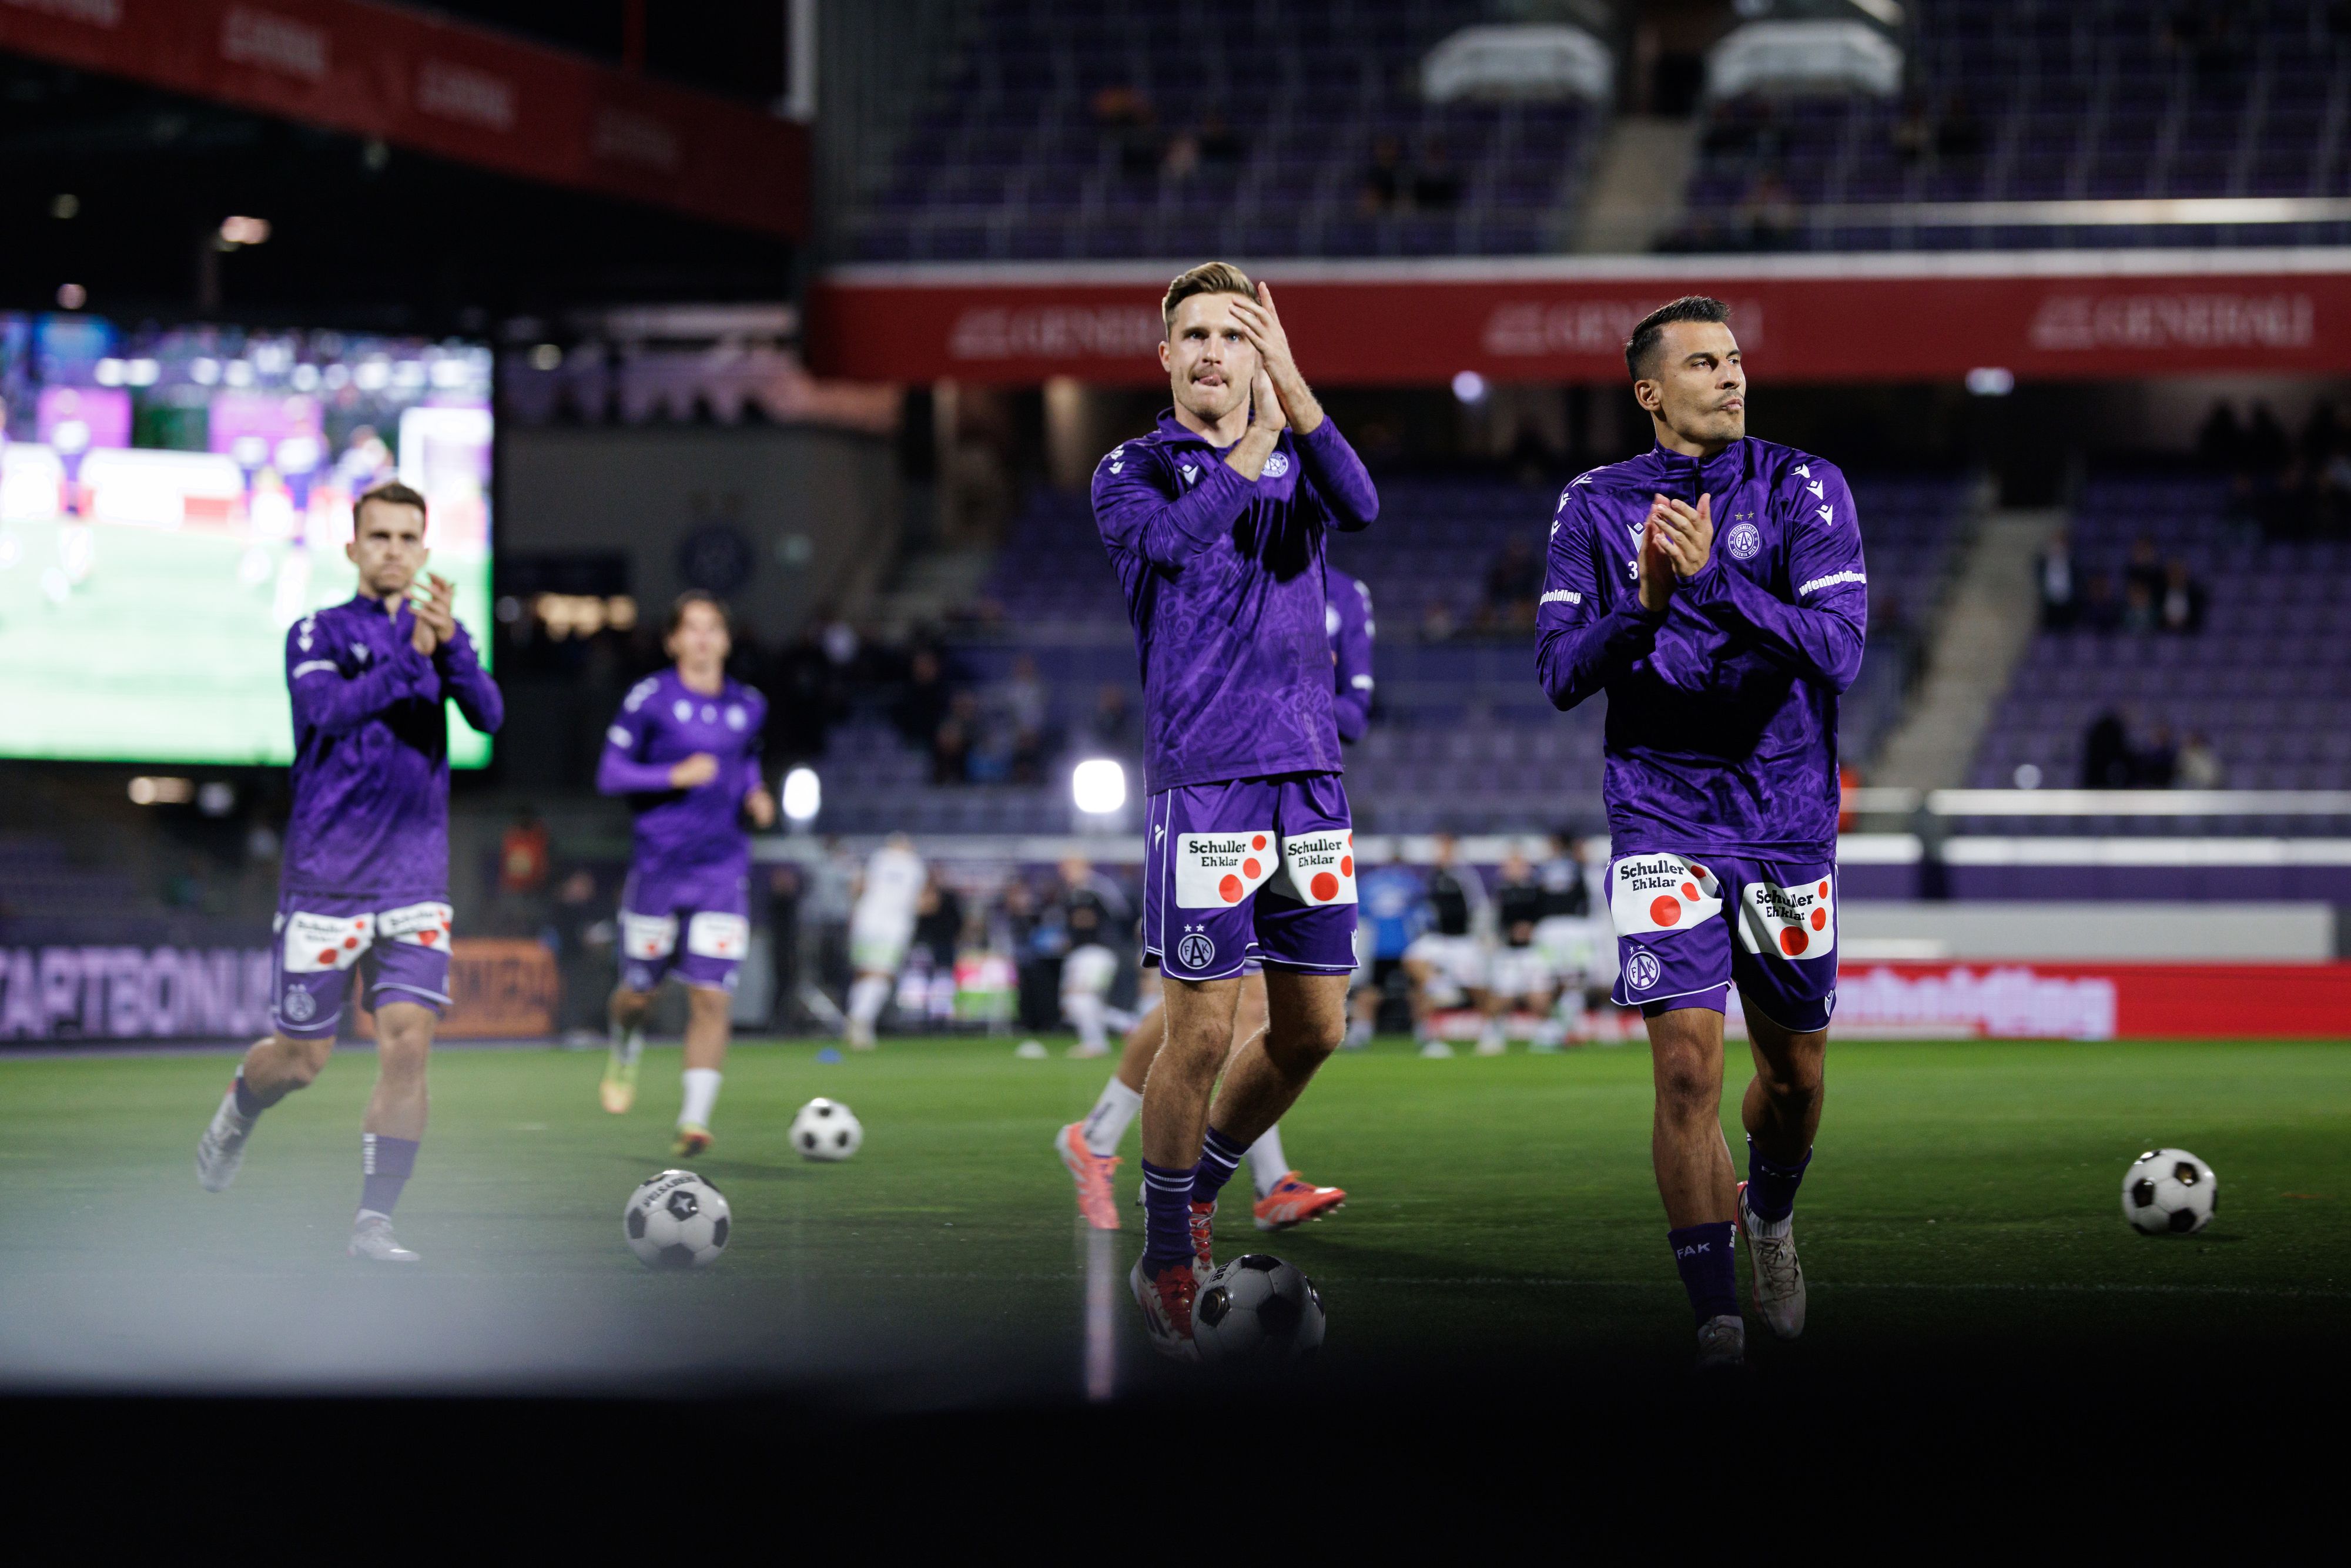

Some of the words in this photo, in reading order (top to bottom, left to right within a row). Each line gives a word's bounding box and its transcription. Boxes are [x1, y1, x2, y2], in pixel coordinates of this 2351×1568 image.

[1731, 525, 1757, 537] FUSSBALLKLUB
[1732, 548, 1748, 557] AUSTRIA
[1747, 545, 1757, 555] WIEN
[1627, 561, 1639, 580] 3
[1189, 840, 1246, 854] Schuller
[1288, 838, 1342, 856] Schuller
[1620, 860, 1684, 880] Schuller
[1756, 889, 1814, 908] Schuller
[1677, 1242, 1710, 1260] FAK
